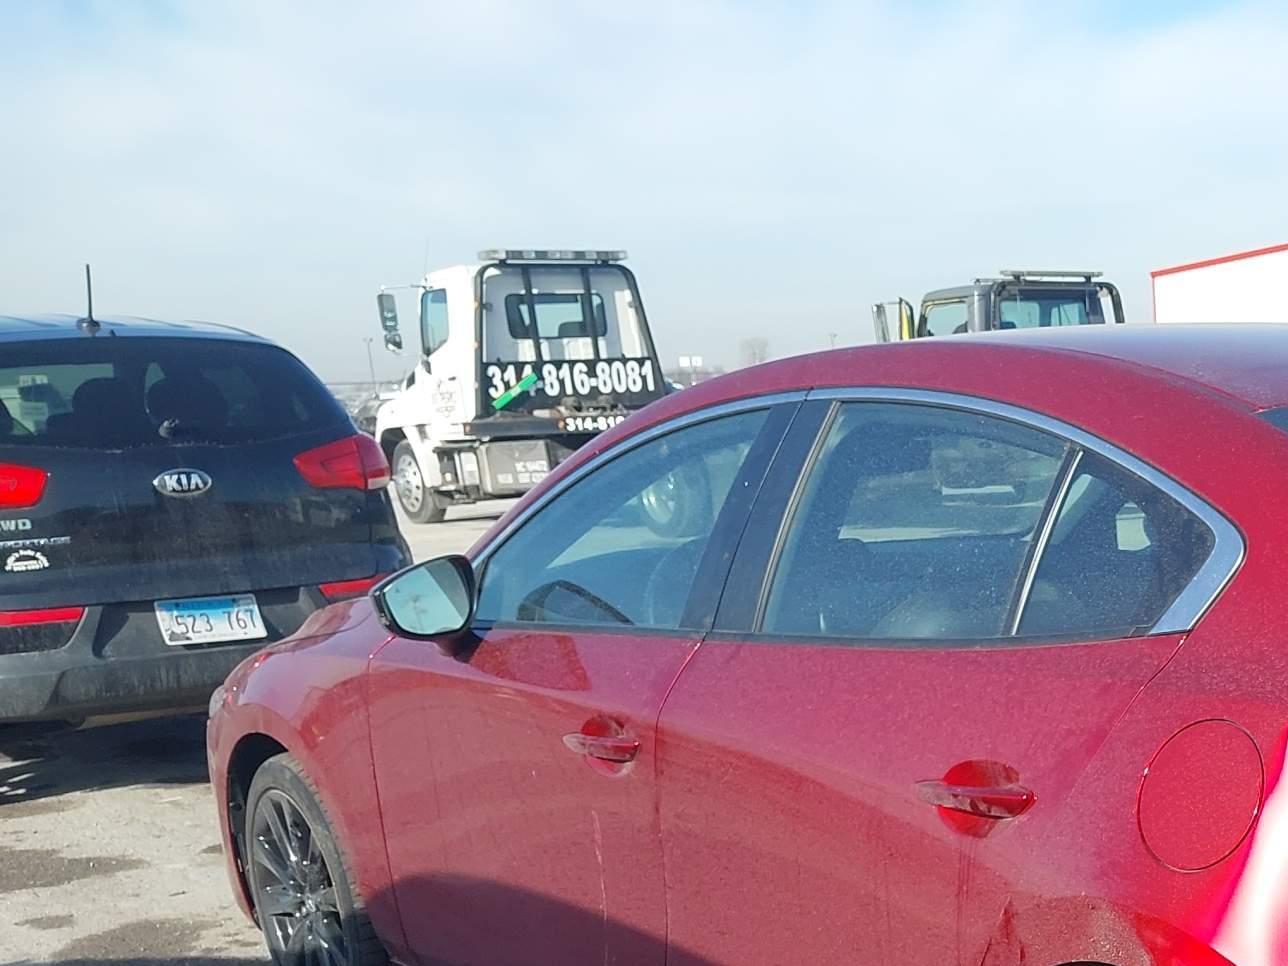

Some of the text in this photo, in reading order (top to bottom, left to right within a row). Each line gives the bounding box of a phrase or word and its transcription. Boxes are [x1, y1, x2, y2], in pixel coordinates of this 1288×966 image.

[164, 473, 204, 491] KIA
[0, 519, 32, 531] WD
[175, 609, 257, 634] 523 767
